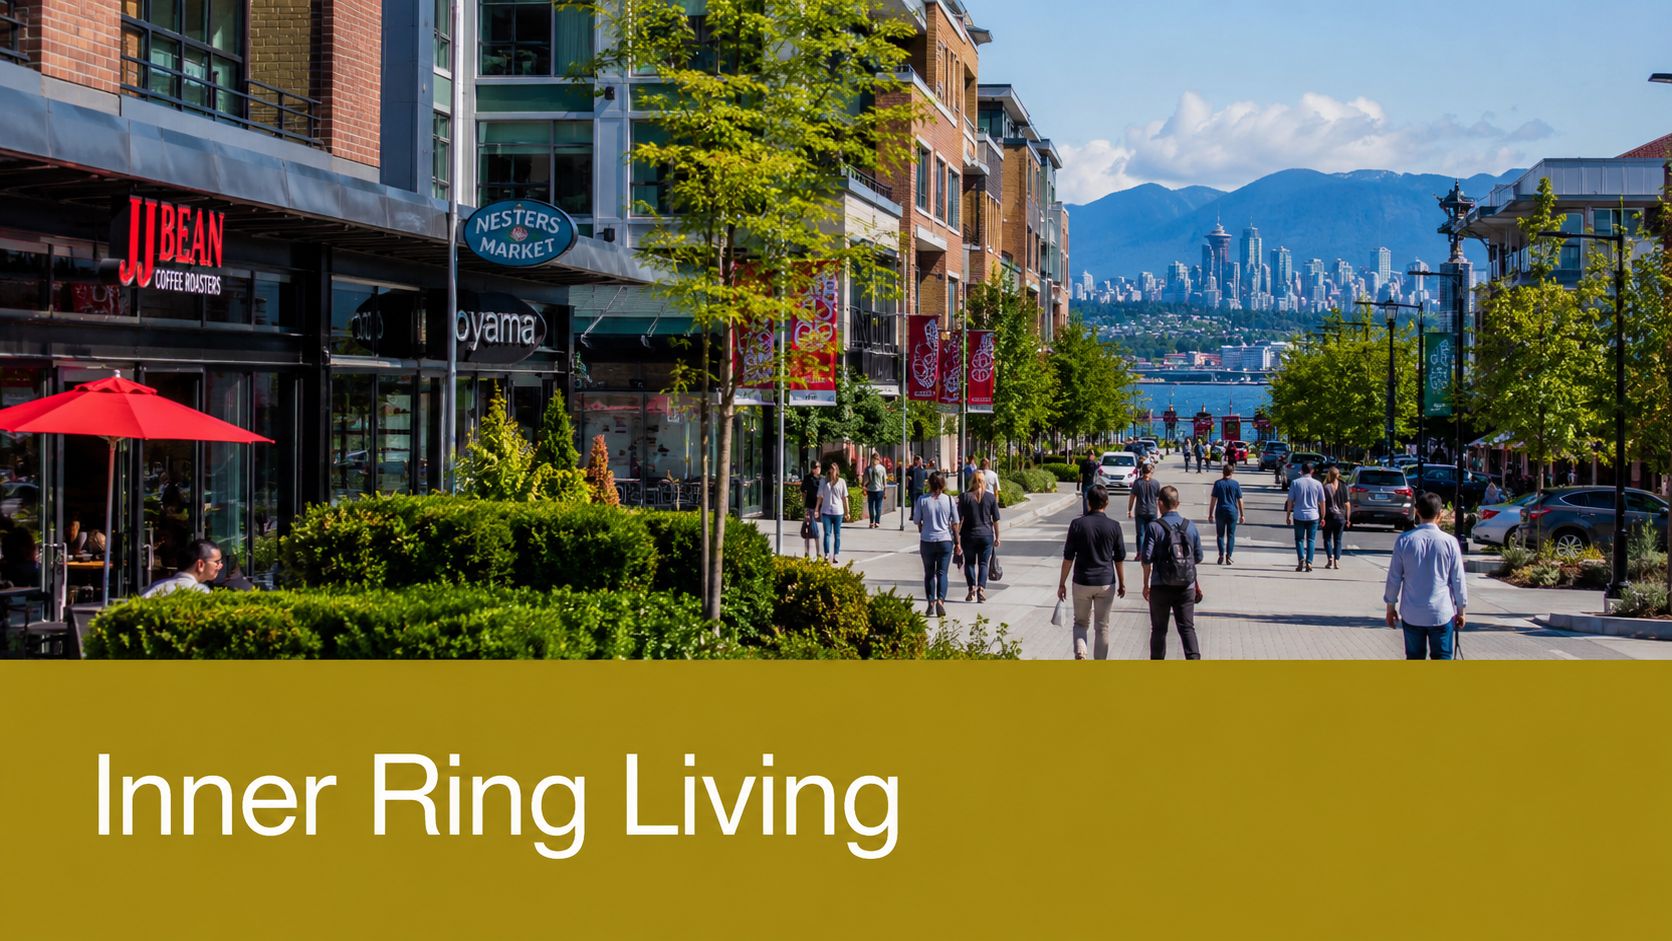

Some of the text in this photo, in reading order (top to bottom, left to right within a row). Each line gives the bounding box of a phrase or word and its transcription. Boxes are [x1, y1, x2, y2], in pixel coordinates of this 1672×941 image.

[475, 209, 561, 234] NESTERS
[119, 196, 225, 288] JJ BEAN
[479, 237, 555, 260] MARKET
[155, 269, 221, 295] COFFEE ROASTERS
[456, 309, 536, 351] oyama
